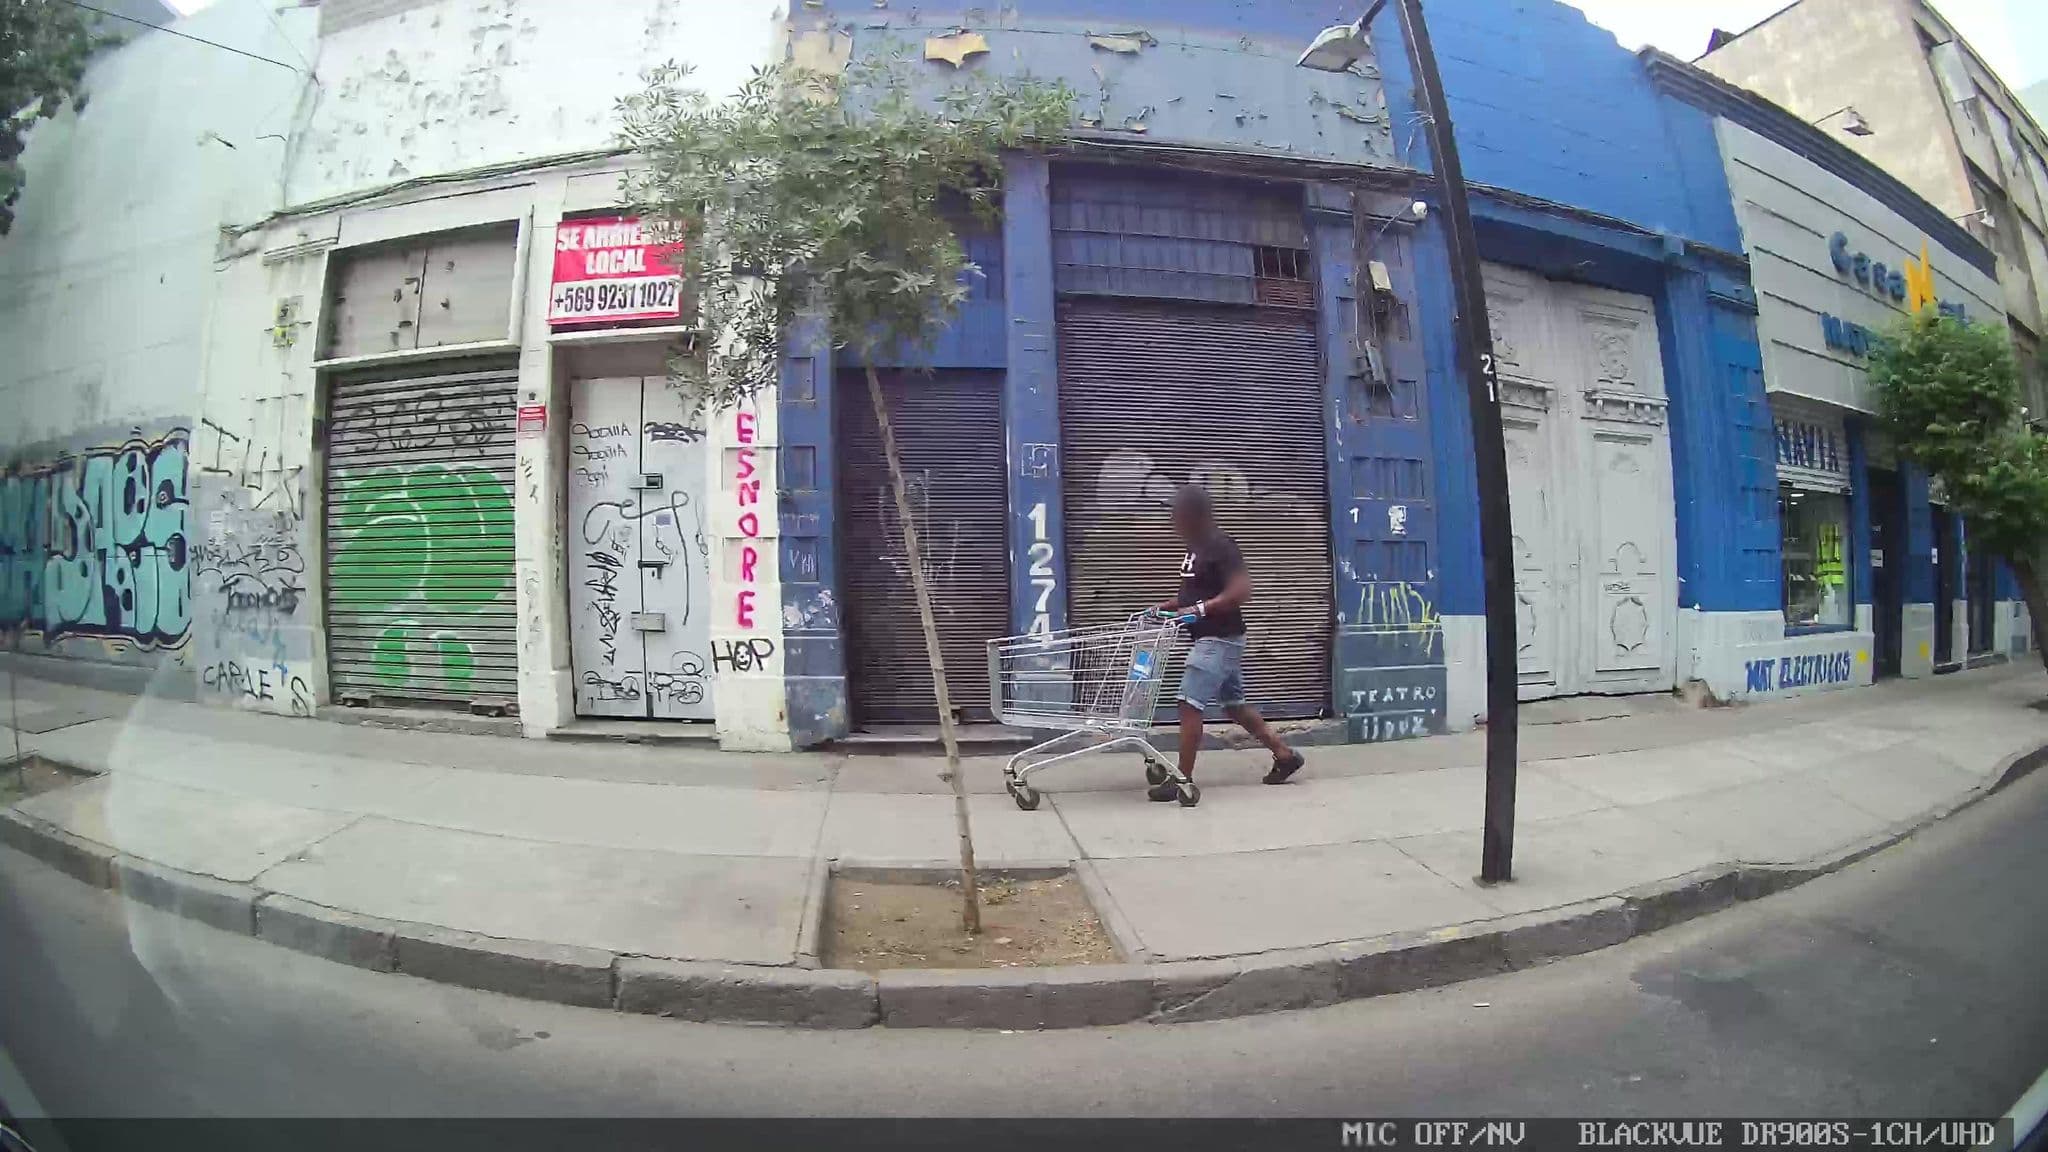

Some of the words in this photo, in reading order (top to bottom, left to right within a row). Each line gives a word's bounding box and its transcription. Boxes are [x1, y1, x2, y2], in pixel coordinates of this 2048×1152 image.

[557, 226, 581, 251] SE
[585, 249, 646, 274] LOCAL
[554, 285, 594, 313] +569
[1352, 686, 1437, 706] TEATRO
